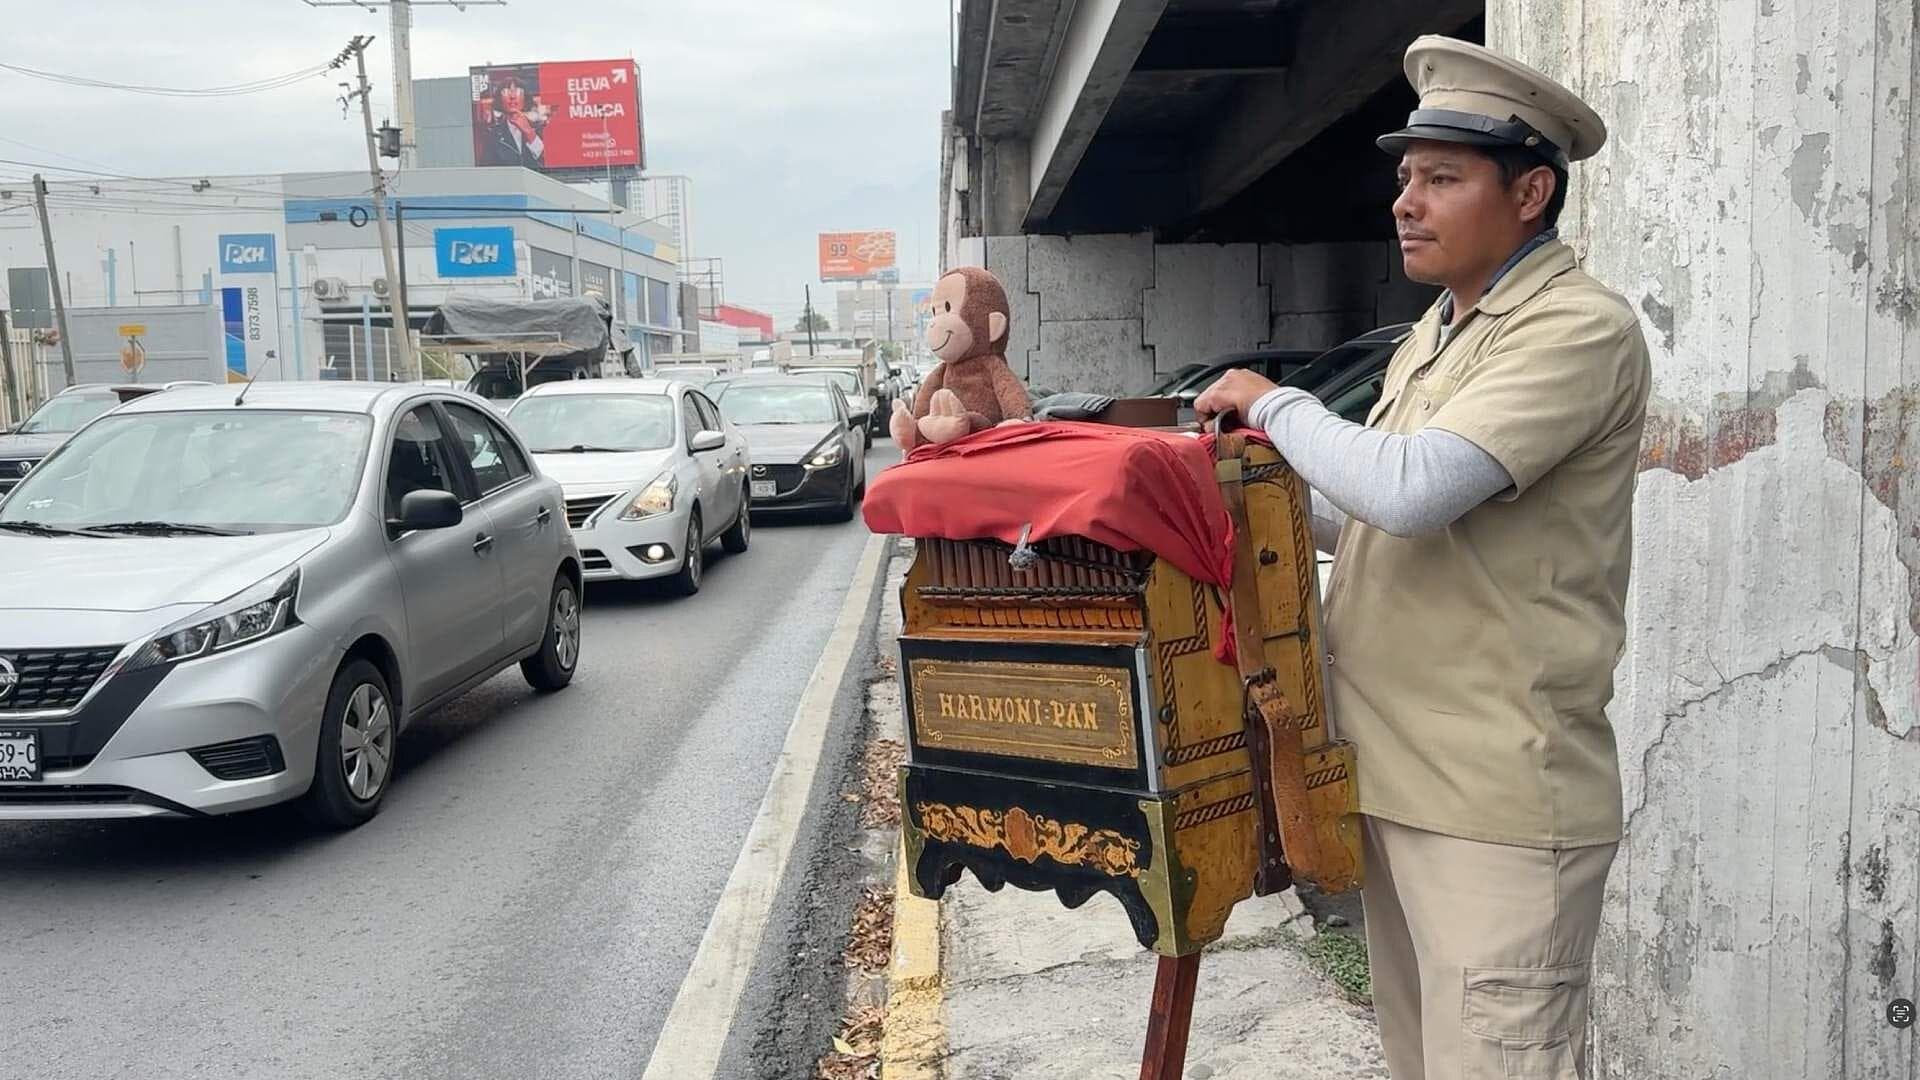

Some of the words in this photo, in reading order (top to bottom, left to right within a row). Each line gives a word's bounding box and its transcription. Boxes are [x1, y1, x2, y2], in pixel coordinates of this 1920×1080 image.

[567, 77, 610, 91] ELEVA
[568, 91, 588, 105] TU
[225, 243, 265, 264] PCH
[450, 240, 499, 265] PCH
[831, 243, 848, 256] 99
